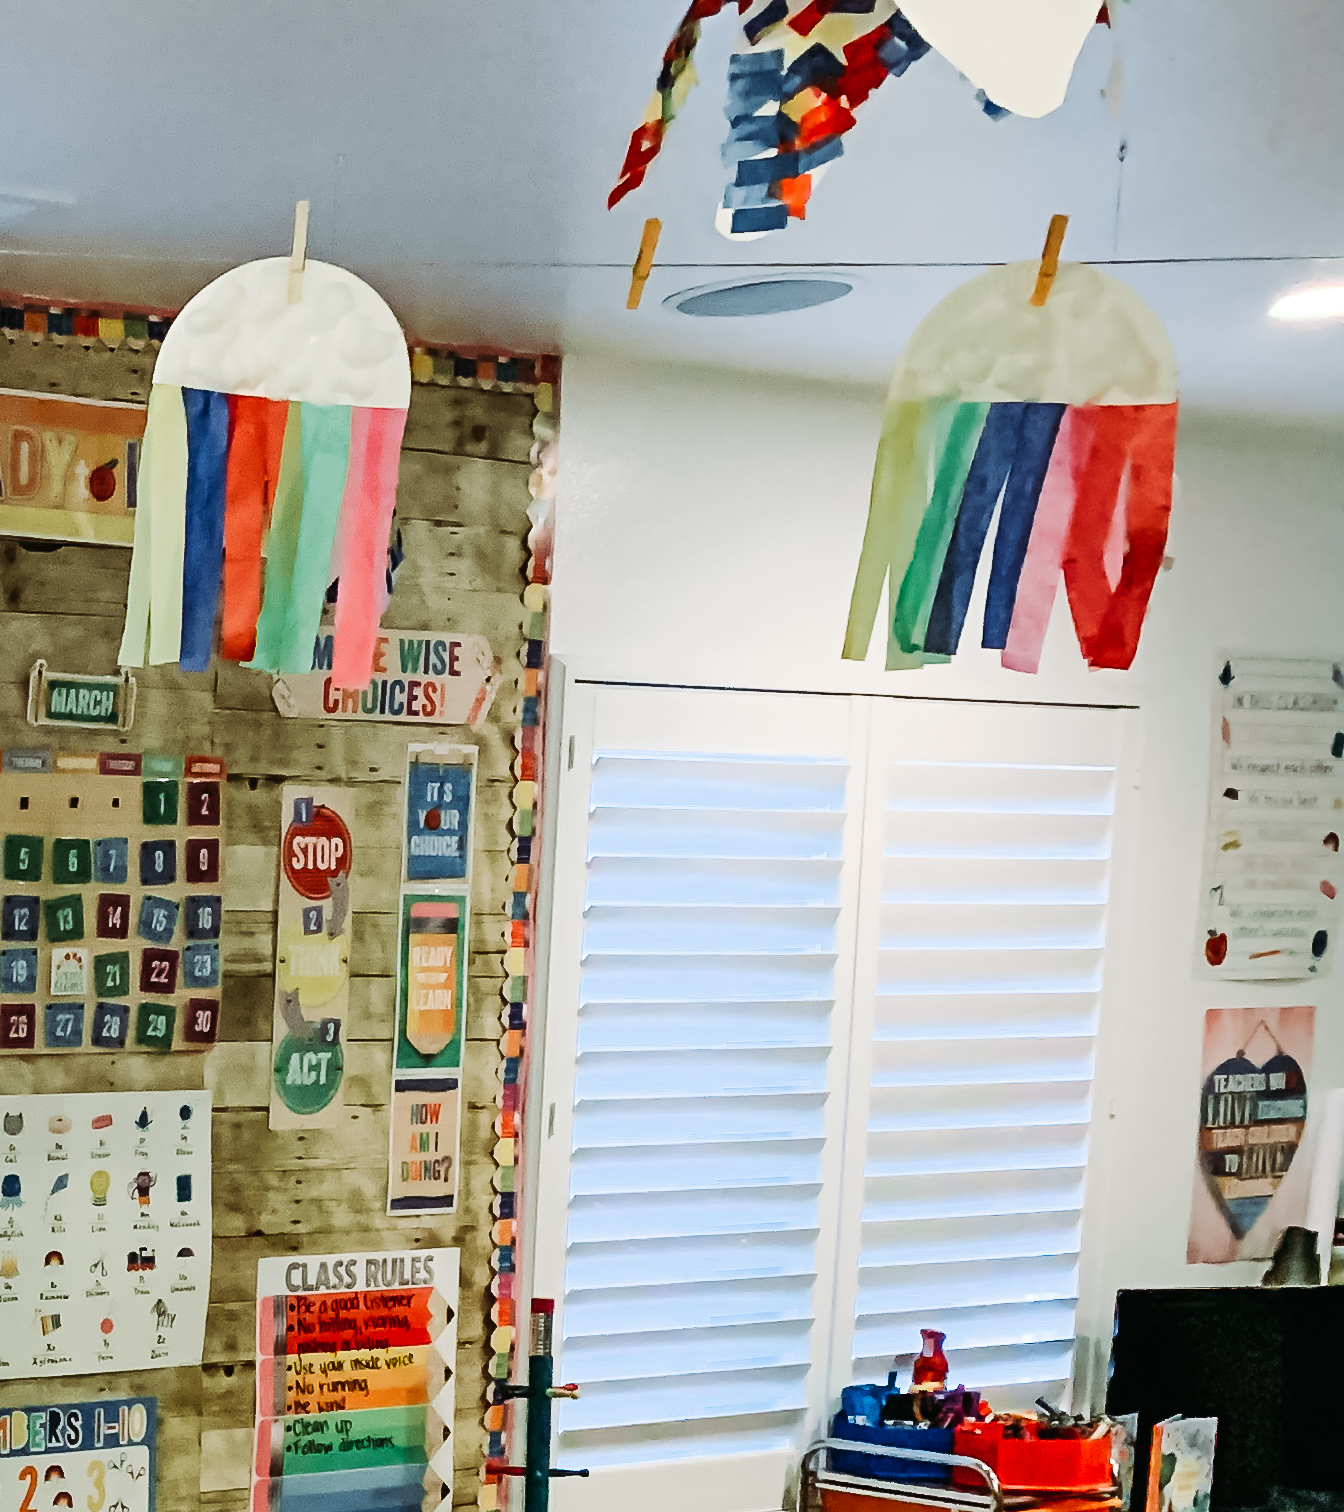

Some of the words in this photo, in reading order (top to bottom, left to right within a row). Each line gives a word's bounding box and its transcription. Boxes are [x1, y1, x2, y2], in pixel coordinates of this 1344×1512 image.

[311, 634, 390, 674] ME
[399, 638, 462, 677] WISE
[50, 687, 113, 717] MARCH
[323, 676, 446, 718] CHOICES!
[292, 835, 344, 871] STOP
[13, 907, 30, 931] 12
[56, 907, 73, 931] 13
[107, 906, 122, 929] 14
[152, 907, 168, 932] 15
[309, 911, 317, 930] 2
[106, 963, 120, 987] 21
[150, 960, 170, 984] 22
[193, 954, 212, 977] 23
[9, 1014, 28, 1038] 26
[55, 1013, 75, 1037] 27
[146, 1013, 167, 1038] 29
[194, 1010, 212, 1032] 30
[285, 1053, 332, 1087] ACT
[411, 1103, 441, 1125] HOW
[410, 1131, 430, 1153] AM
[434, 1131, 439, 1152] I
[401, 1155, 452, 1183] DOING?
[285, 1257, 357, 1293] CLASS
[365, 1254, 434, 1287] RULES
[334, 1419, 353, 1438] up
[86, 1459, 108, 1512] 3
